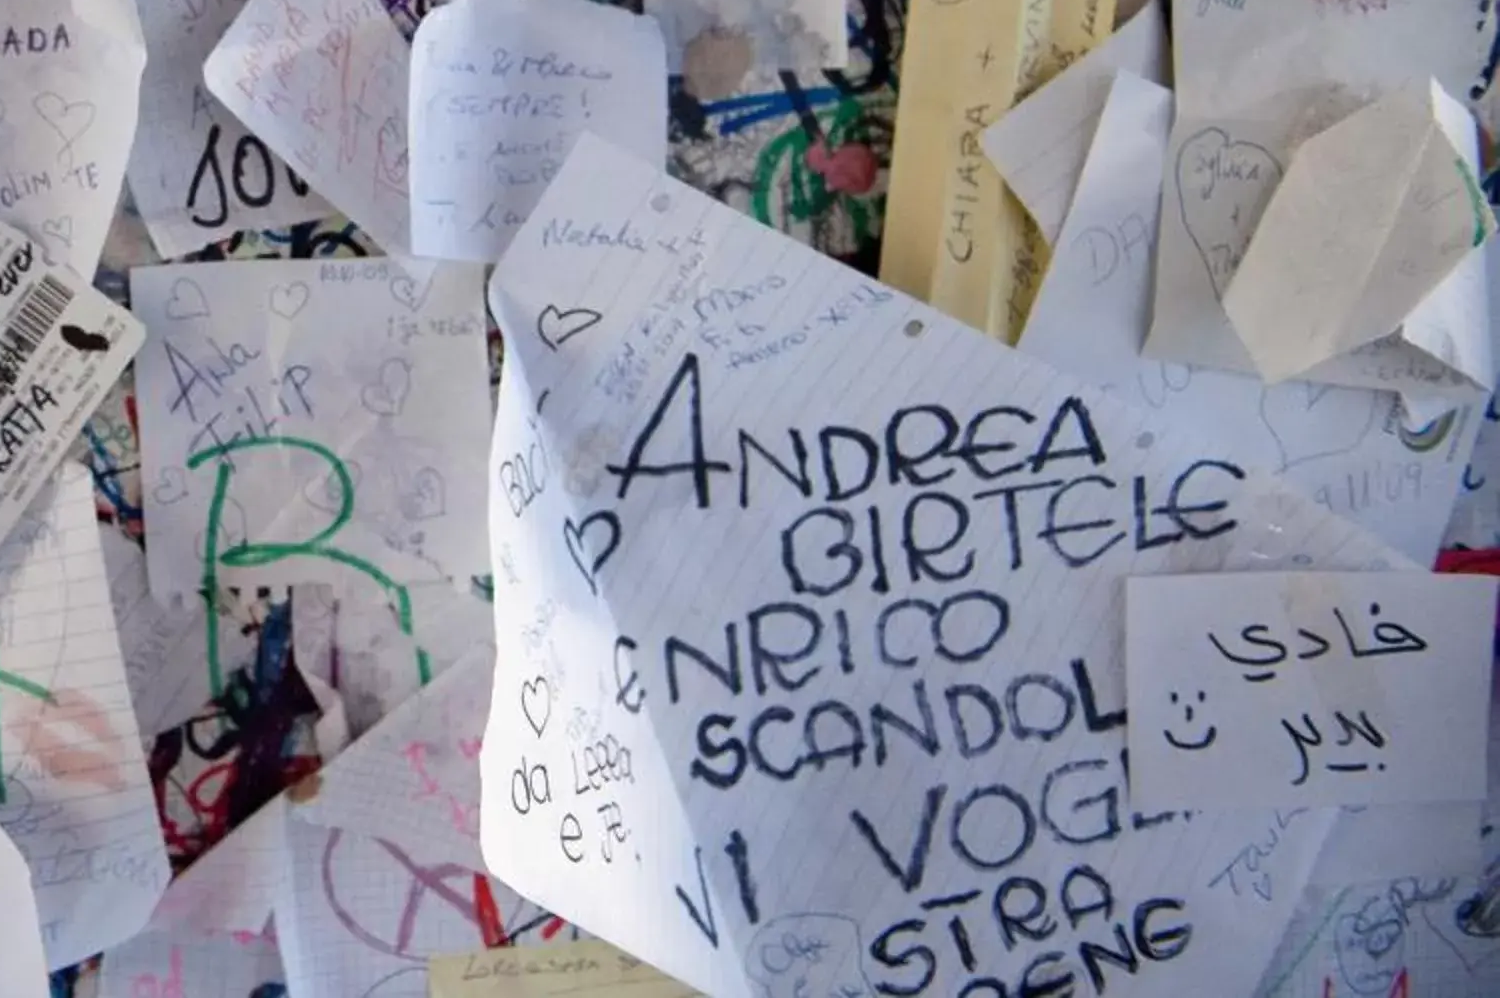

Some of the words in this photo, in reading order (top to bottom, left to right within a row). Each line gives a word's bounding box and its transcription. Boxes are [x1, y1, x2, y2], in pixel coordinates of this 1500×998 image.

[946, 102, 991, 266] CHIARA
[605, 352, 1107, 510] ANDREA
[1208, 601, 1429, 684] فادي
[870, 864, 1114, 996] STRA
